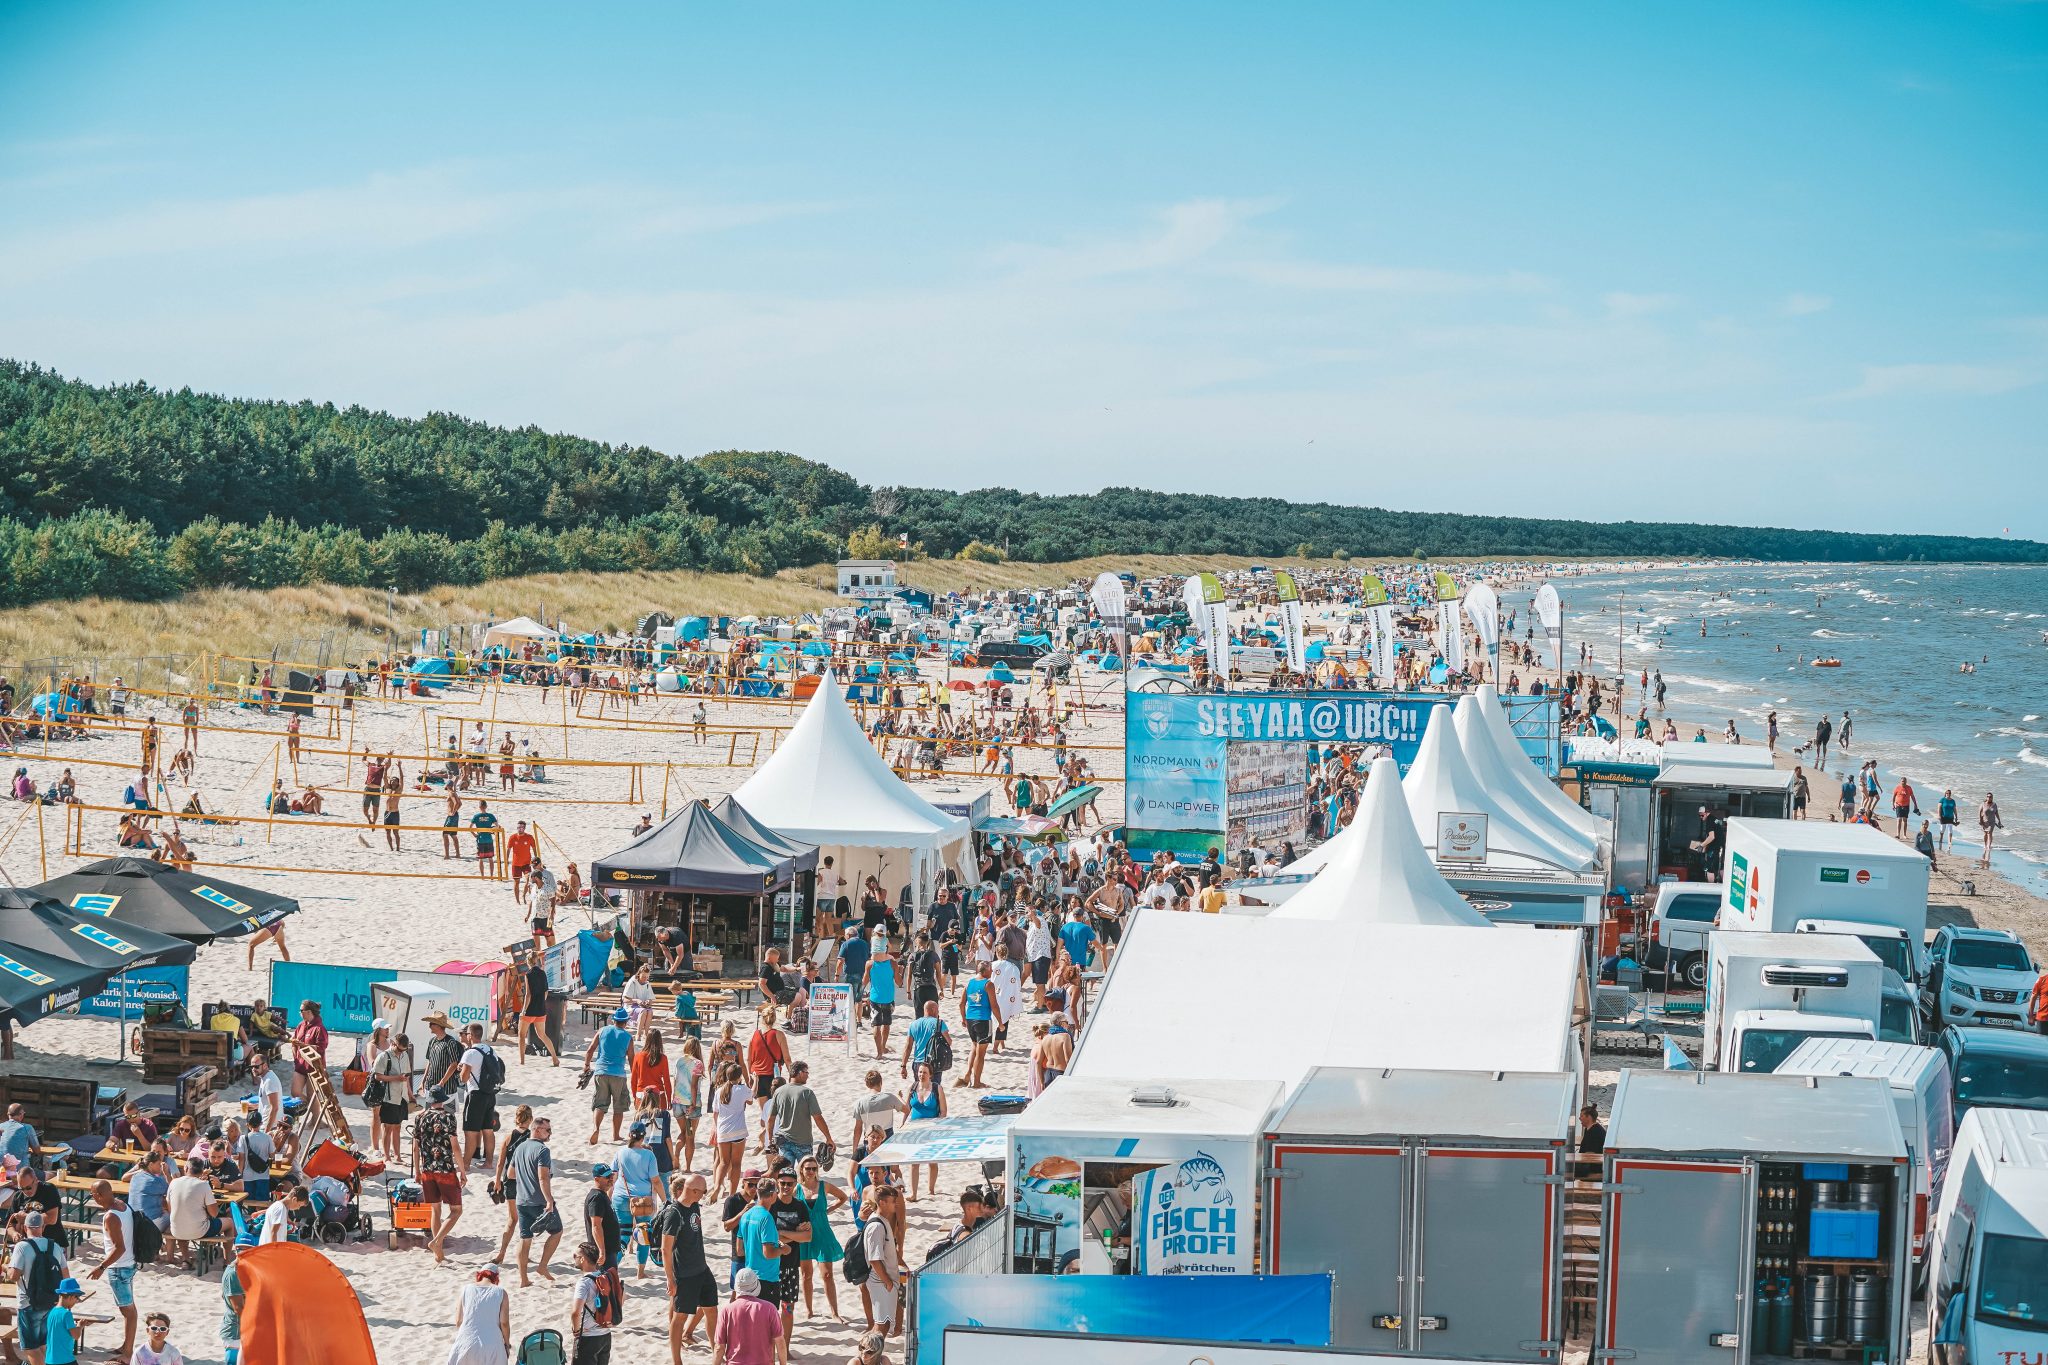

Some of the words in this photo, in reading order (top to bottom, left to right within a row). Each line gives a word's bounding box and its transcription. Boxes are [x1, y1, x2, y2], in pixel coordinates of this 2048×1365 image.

[1133, 754, 1201, 767] NORDMANN
[1148, 800, 1220, 812] DANPOWER
[332, 992, 371, 1013] NDR
[383, 995, 397, 1011] 78
[427, 999, 436, 1010] 78
[349, 1013, 371, 1022] Radio
[448, 1004, 489, 1024] agazi
[1159, 1189, 1175, 1204] DER
[1153, 1207, 1236, 1240] FISCH
[1163, 1234, 1236, 1258] PROFI
